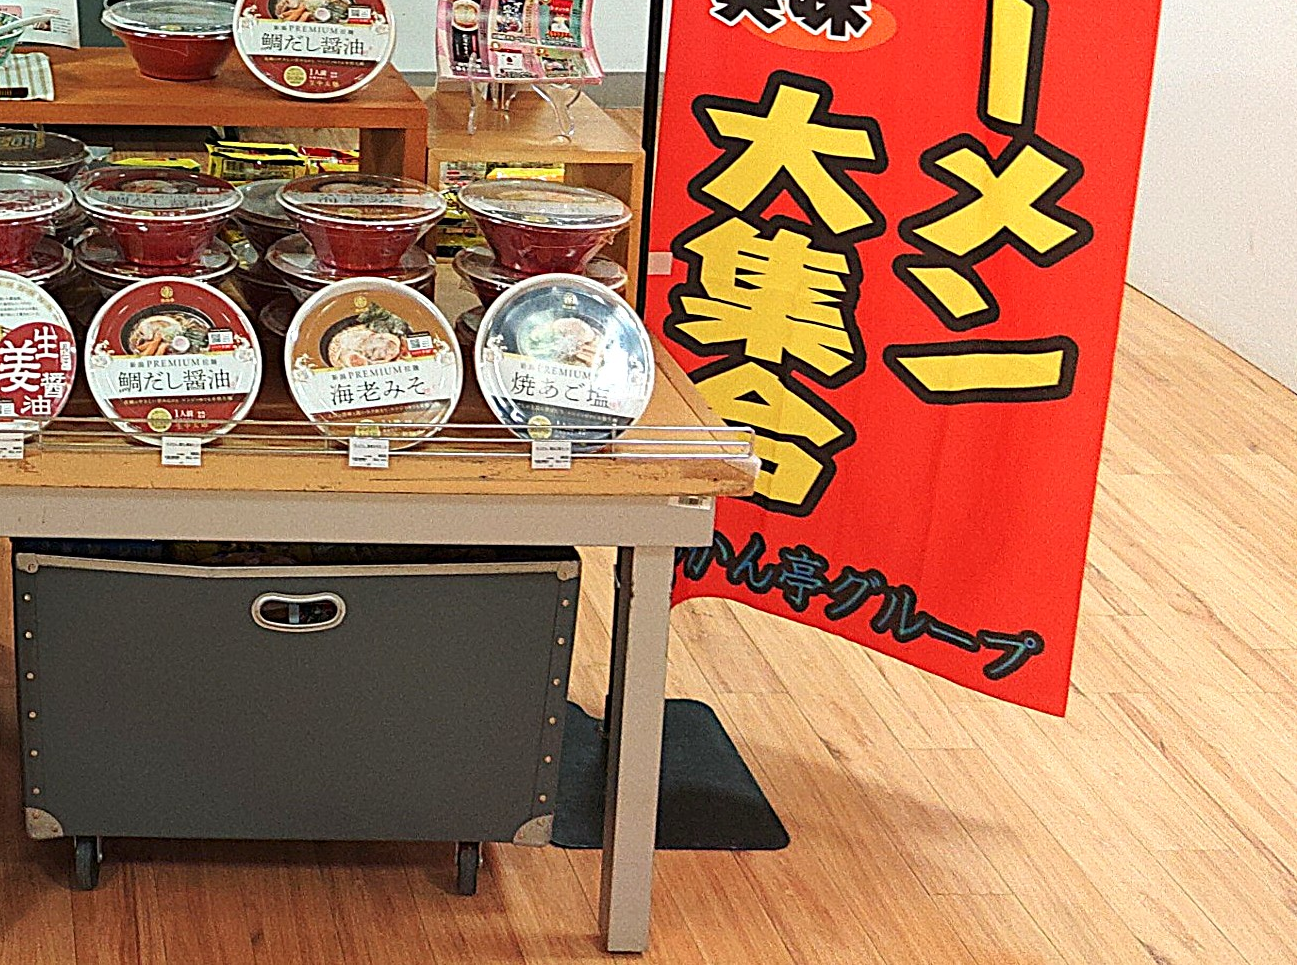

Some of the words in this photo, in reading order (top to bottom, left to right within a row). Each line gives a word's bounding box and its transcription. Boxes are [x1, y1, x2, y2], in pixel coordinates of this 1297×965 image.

[260, 33, 364, 55] 鯛だし醤油
[664, 70, 888, 516] 大集合
[20, 372, 66, 416] 醤油
[119, 368, 231, 394] 鯛だし醤油
[330, 376, 426, 406] 海老みそ
[511, 372, 610, 410] 焼あご塩
